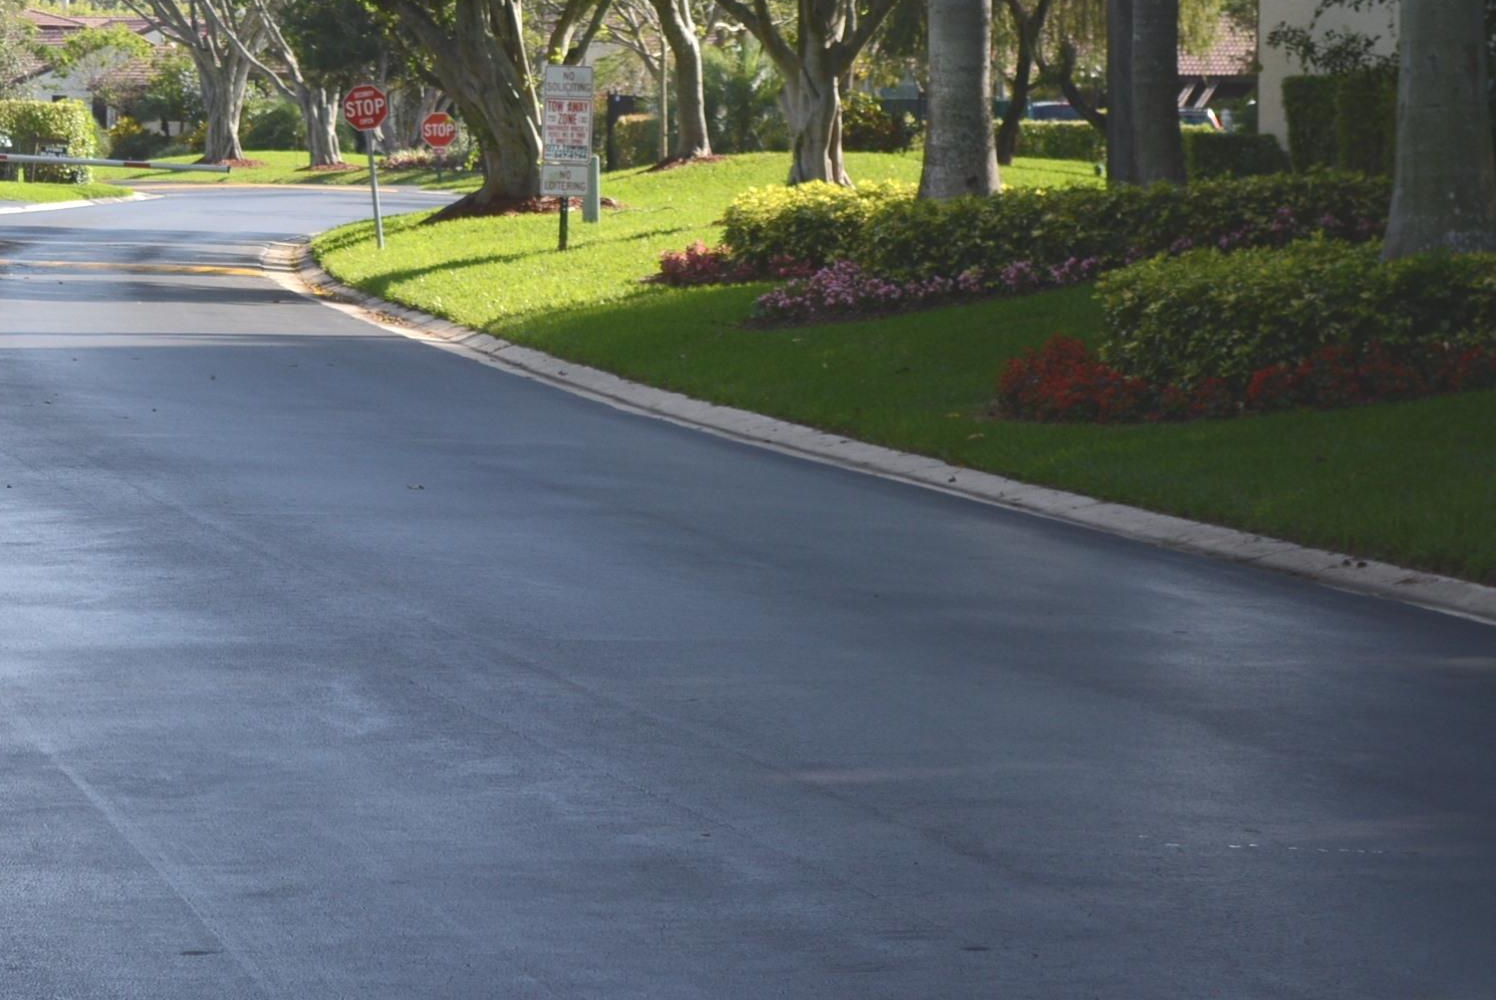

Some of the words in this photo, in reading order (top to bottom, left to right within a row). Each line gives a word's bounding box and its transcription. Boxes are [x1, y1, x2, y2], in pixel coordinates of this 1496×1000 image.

[563, 71, 575, 80] NO
[547, 82, 592, 92] SOLICITING
[345, 98, 385, 118] STOP
[547, 100, 564, 112] TOW
[567, 101, 588, 113] AWAY
[558, 113, 577, 125] ZONE
[424, 123, 454, 137] STOP
[559, 170, 571, 180] NO
[544, 181, 586, 191] LOITERING
